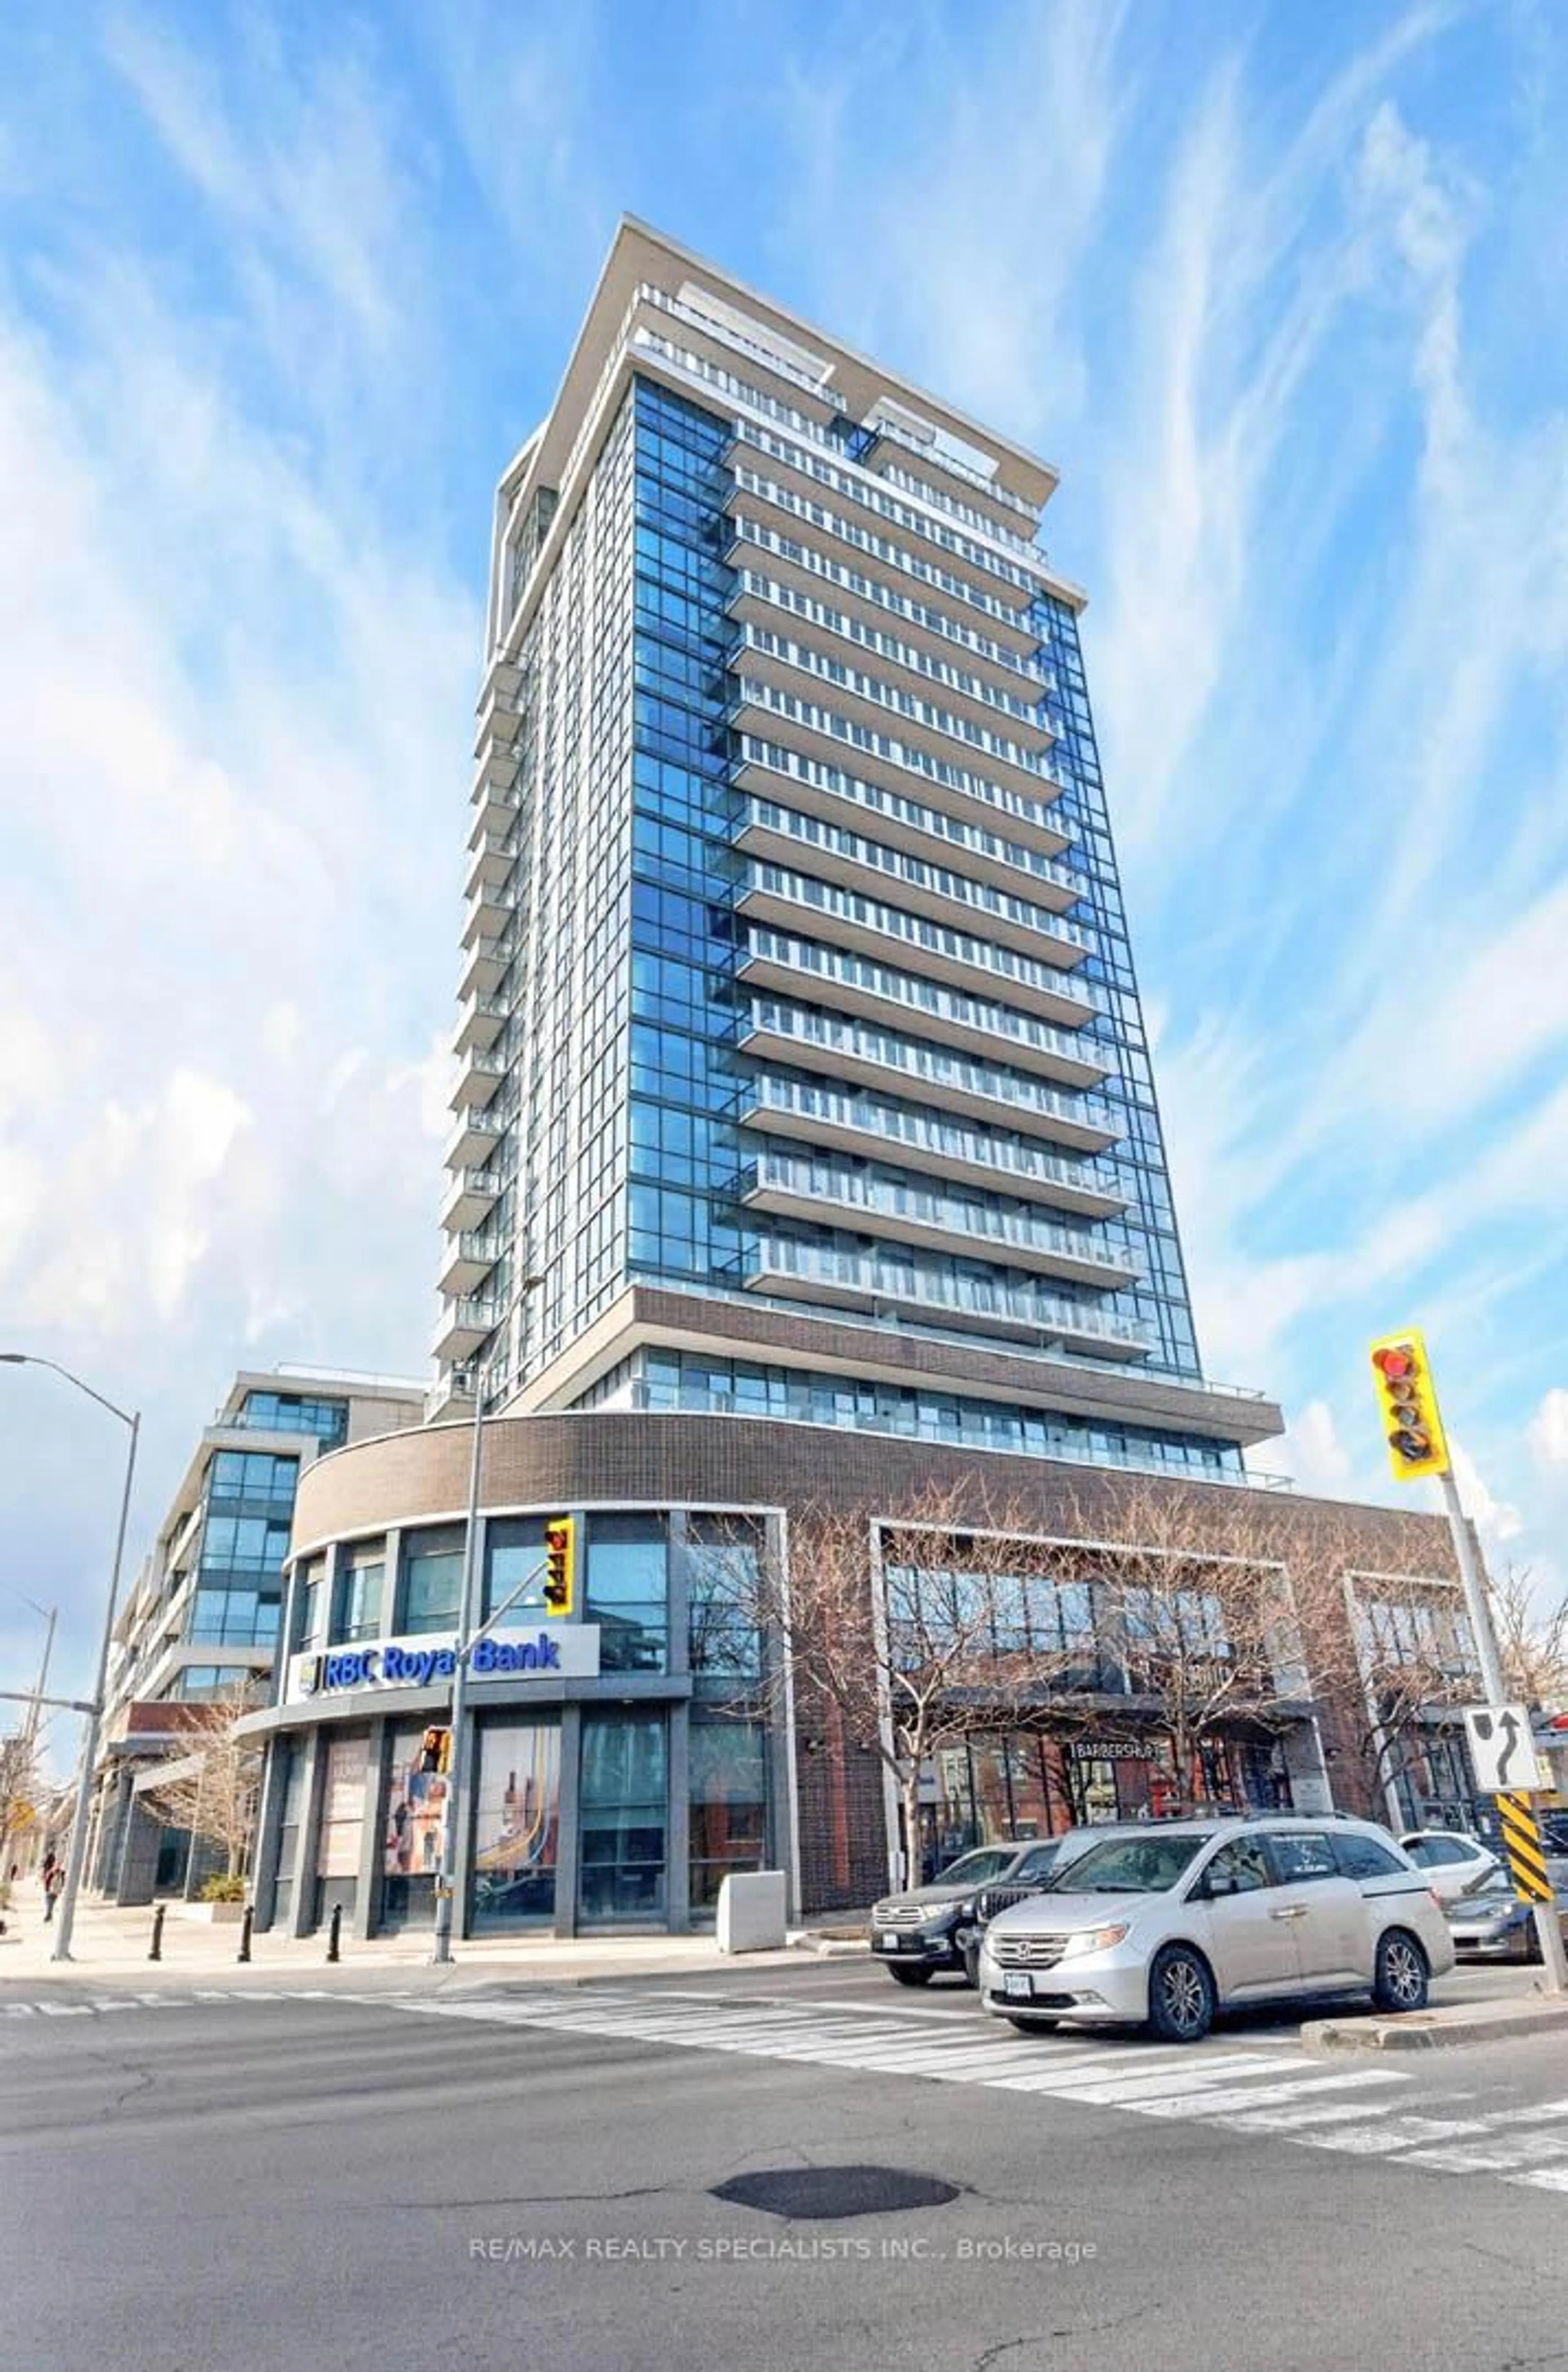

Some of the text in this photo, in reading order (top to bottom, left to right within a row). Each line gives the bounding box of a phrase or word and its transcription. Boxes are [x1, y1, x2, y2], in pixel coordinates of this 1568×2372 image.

[326, 1633, 561, 1688] RBC Roya Bank
